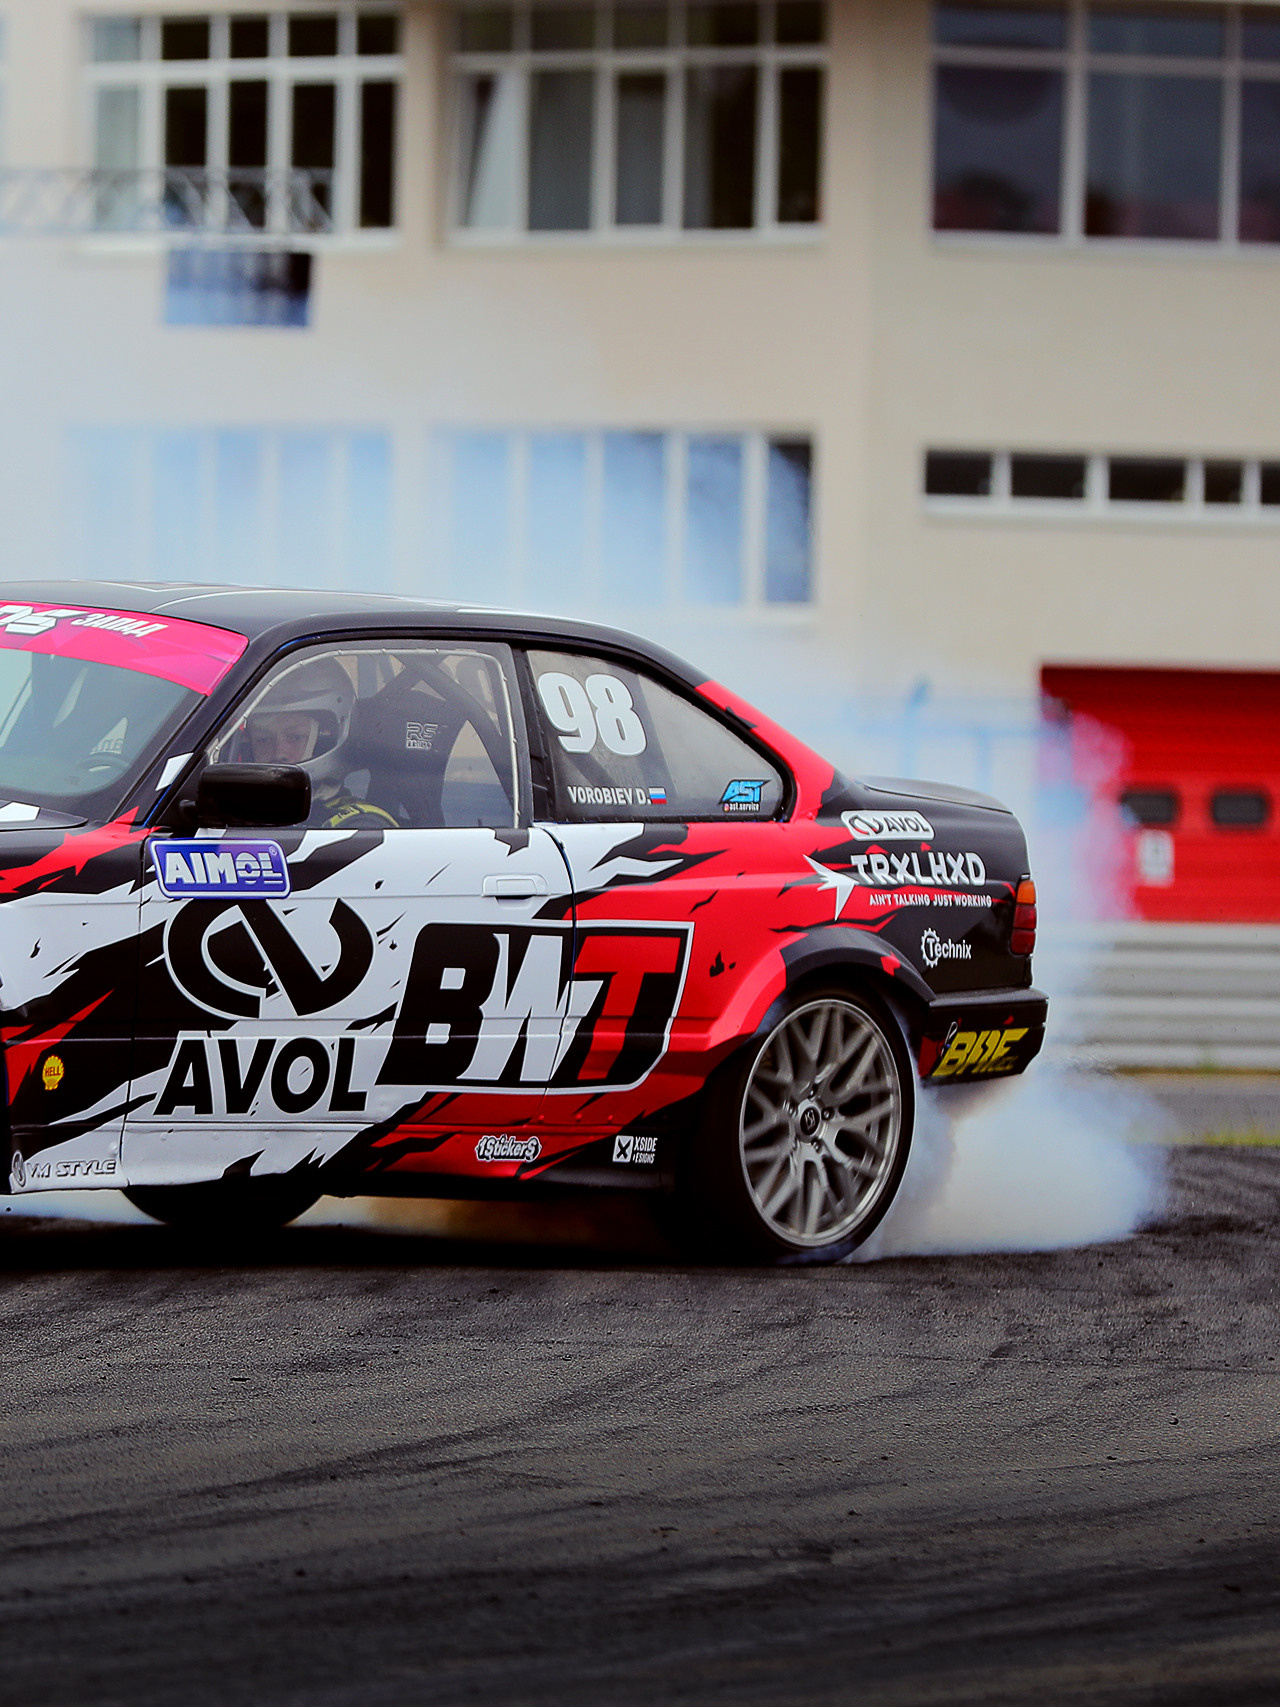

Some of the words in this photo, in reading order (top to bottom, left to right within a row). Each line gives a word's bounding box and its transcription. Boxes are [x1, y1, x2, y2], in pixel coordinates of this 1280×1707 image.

[70, 613, 169, 638] ЗАПАД
[538, 672, 647, 756] 98
[567, 785, 633, 805] VOROBIEV
[887, 816, 930, 832] AVOL
[851, 852, 986, 886] TRXLHXD
[869, 893, 892, 906] AIN'T
[893, 893, 930, 907] TALKING
[933, 894, 953, 907] JUST
[954, 894, 992, 908] WORKING
[925, 937, 972, 960] Technix
[376, 923, 682, 1087] BWT
[44, 1065, 61, 1077] HELL
[153, 1036, 368, 1116] AVOL
[634, 1136, 658, 1152] XSIDE
[56, 1160, 117, 1176] STYLE
